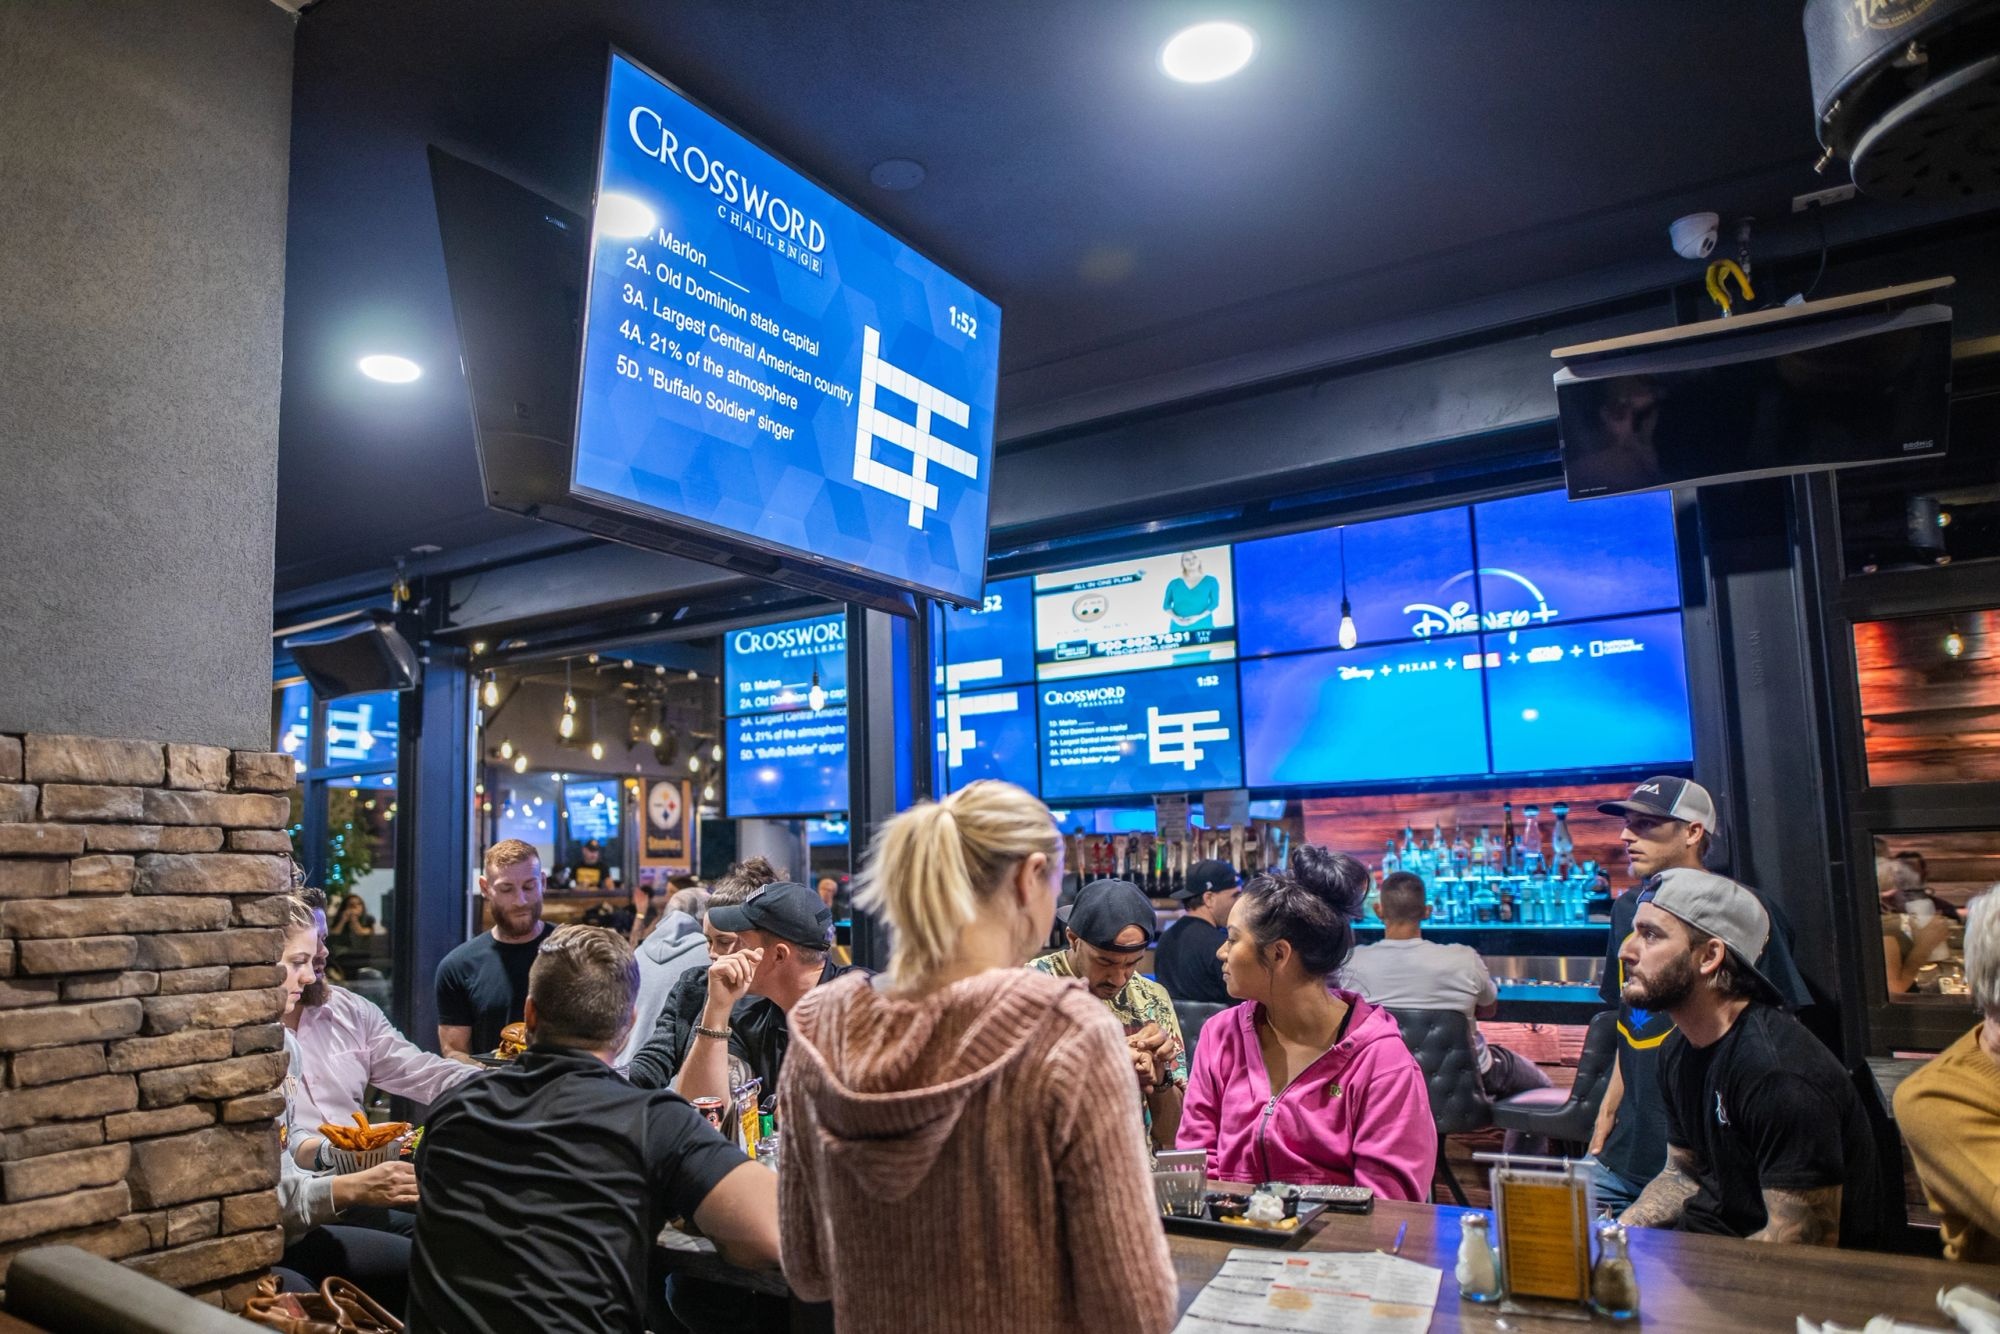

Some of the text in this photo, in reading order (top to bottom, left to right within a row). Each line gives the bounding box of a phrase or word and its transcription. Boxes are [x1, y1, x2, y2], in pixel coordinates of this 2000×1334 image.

[629, 106, 825, 253] CROSSWORD
[658, 228, 707, 268] Marlon
[717, 204, 821, 274] CHALLENGE
[625, 247, 820, 357] 2A. Old Dominion state capital
[949, 305, 977, 340] 1:52
[619, 319, 798, 411] 4A. 21% of the atmosphere
[622, 283, 854, 407] 3A. Largest Central American country
[616, 353, 795, 441] 5D. "Buffalo Soldier" singer
[734, 620, 846, 655] CROSSWOR
[1398, 661, 1437, 674] PIXAR
